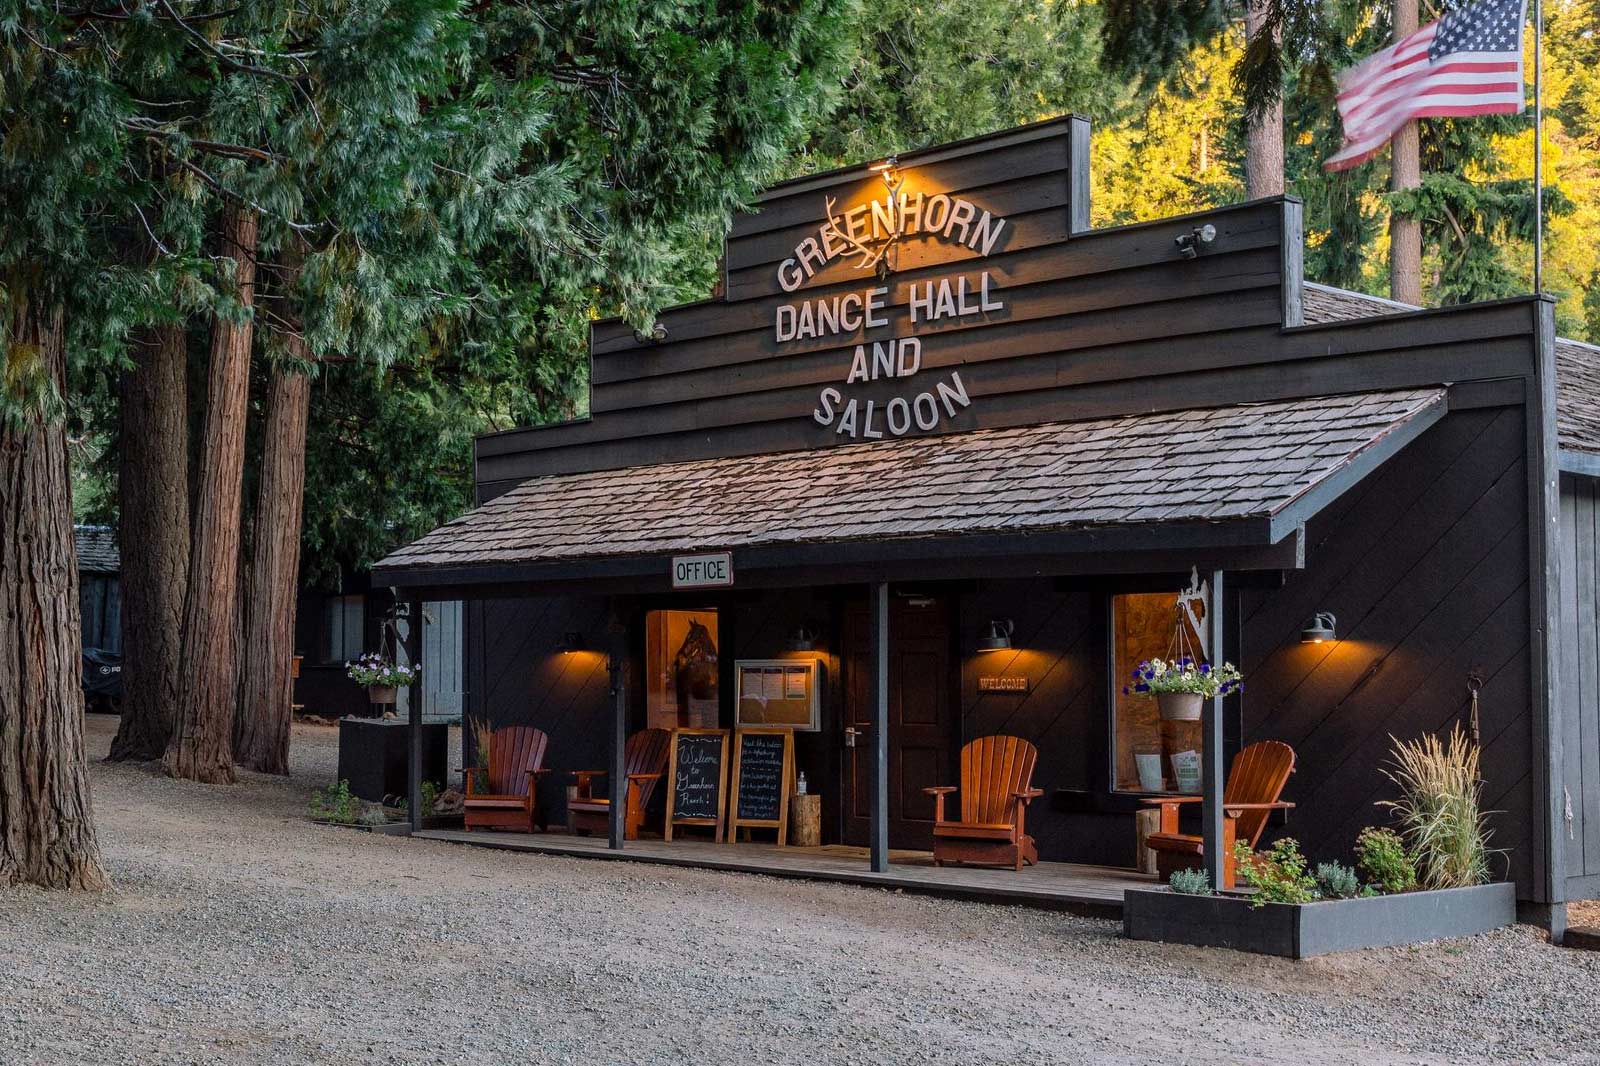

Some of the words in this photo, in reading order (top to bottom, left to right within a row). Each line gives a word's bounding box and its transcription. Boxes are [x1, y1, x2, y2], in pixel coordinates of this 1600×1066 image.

[777, 192, 1006, 292] GREENHORN
[776, 287, 888, 342] DANCE
[909, 272, 1003, 322] HALL
[847, 337, 921, 384] AND
[813, 372, 971, 438] SALOON
[676, 560, 726, 581] OFFICE
[980, 678, 1025, 690] WELCOME
